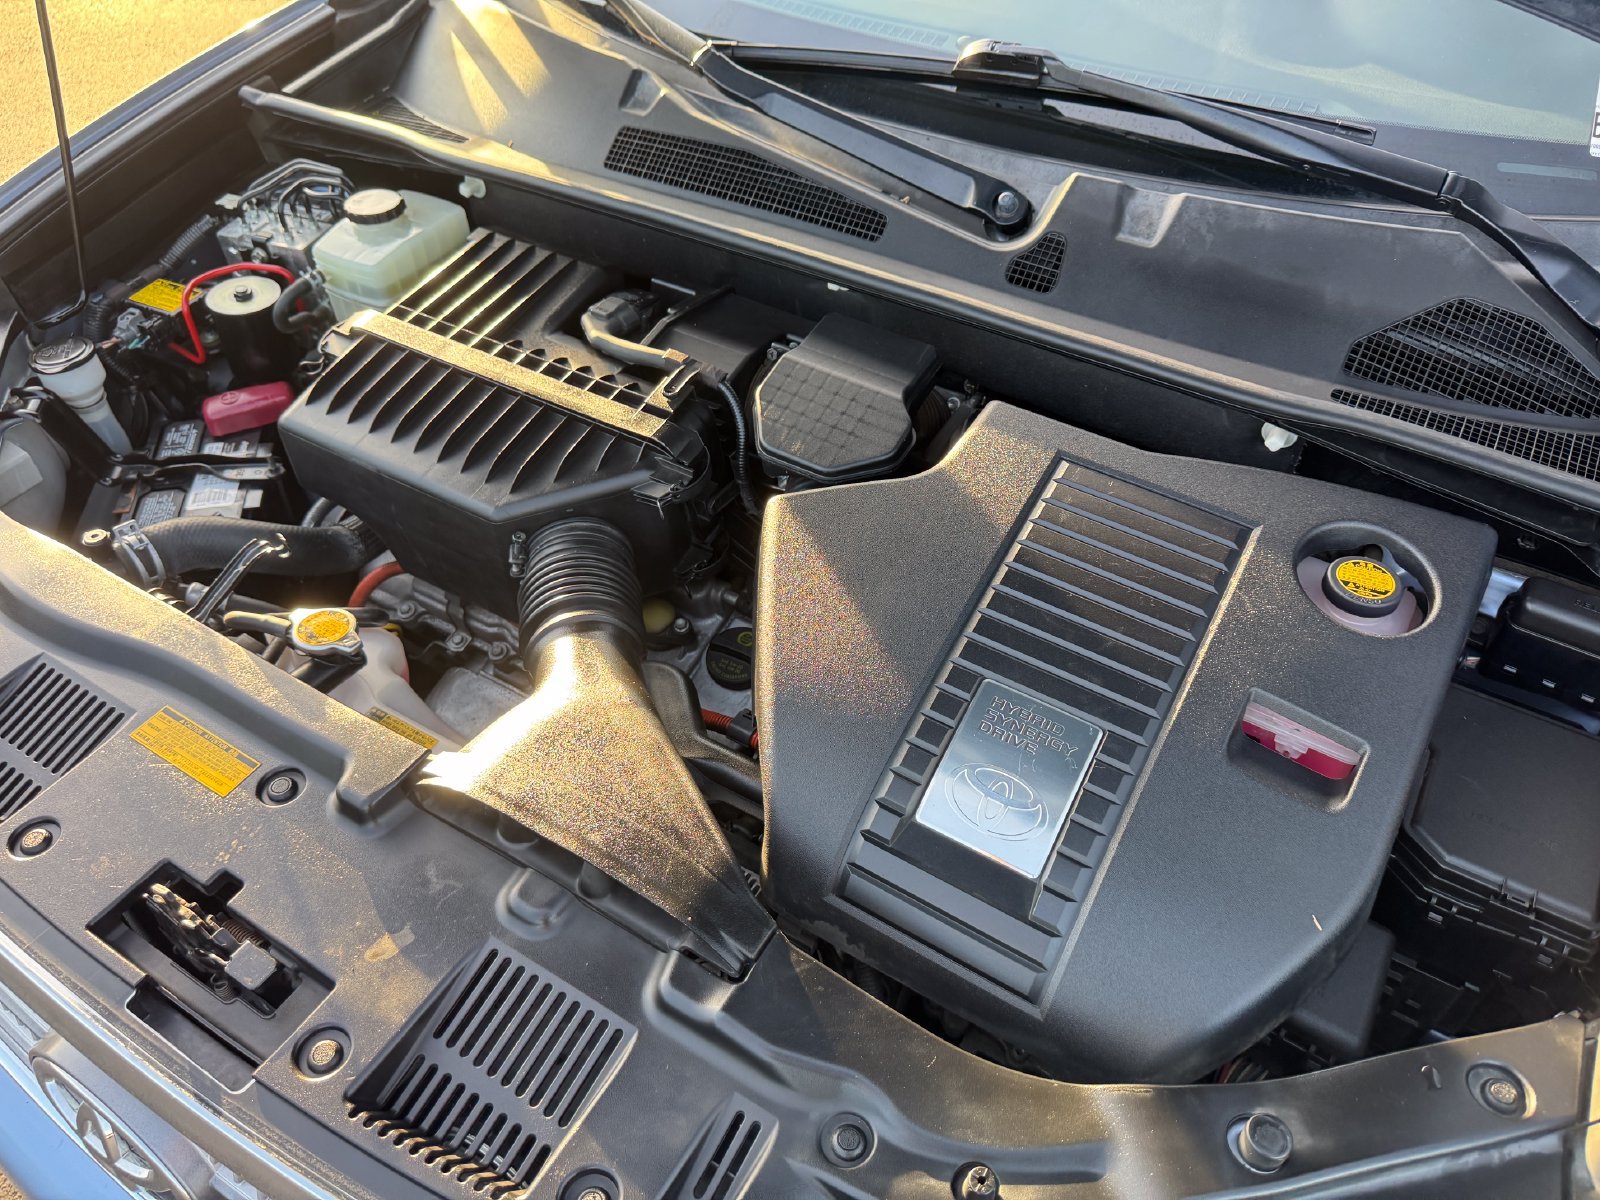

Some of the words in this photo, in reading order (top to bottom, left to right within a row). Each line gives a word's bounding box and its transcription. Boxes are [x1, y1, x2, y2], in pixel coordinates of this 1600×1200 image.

[984, 707, 1079, 757] SYNERGY
[991, 695, 1065, 736] HYBRID
[979, 719, 1039, 756] DRIVE
